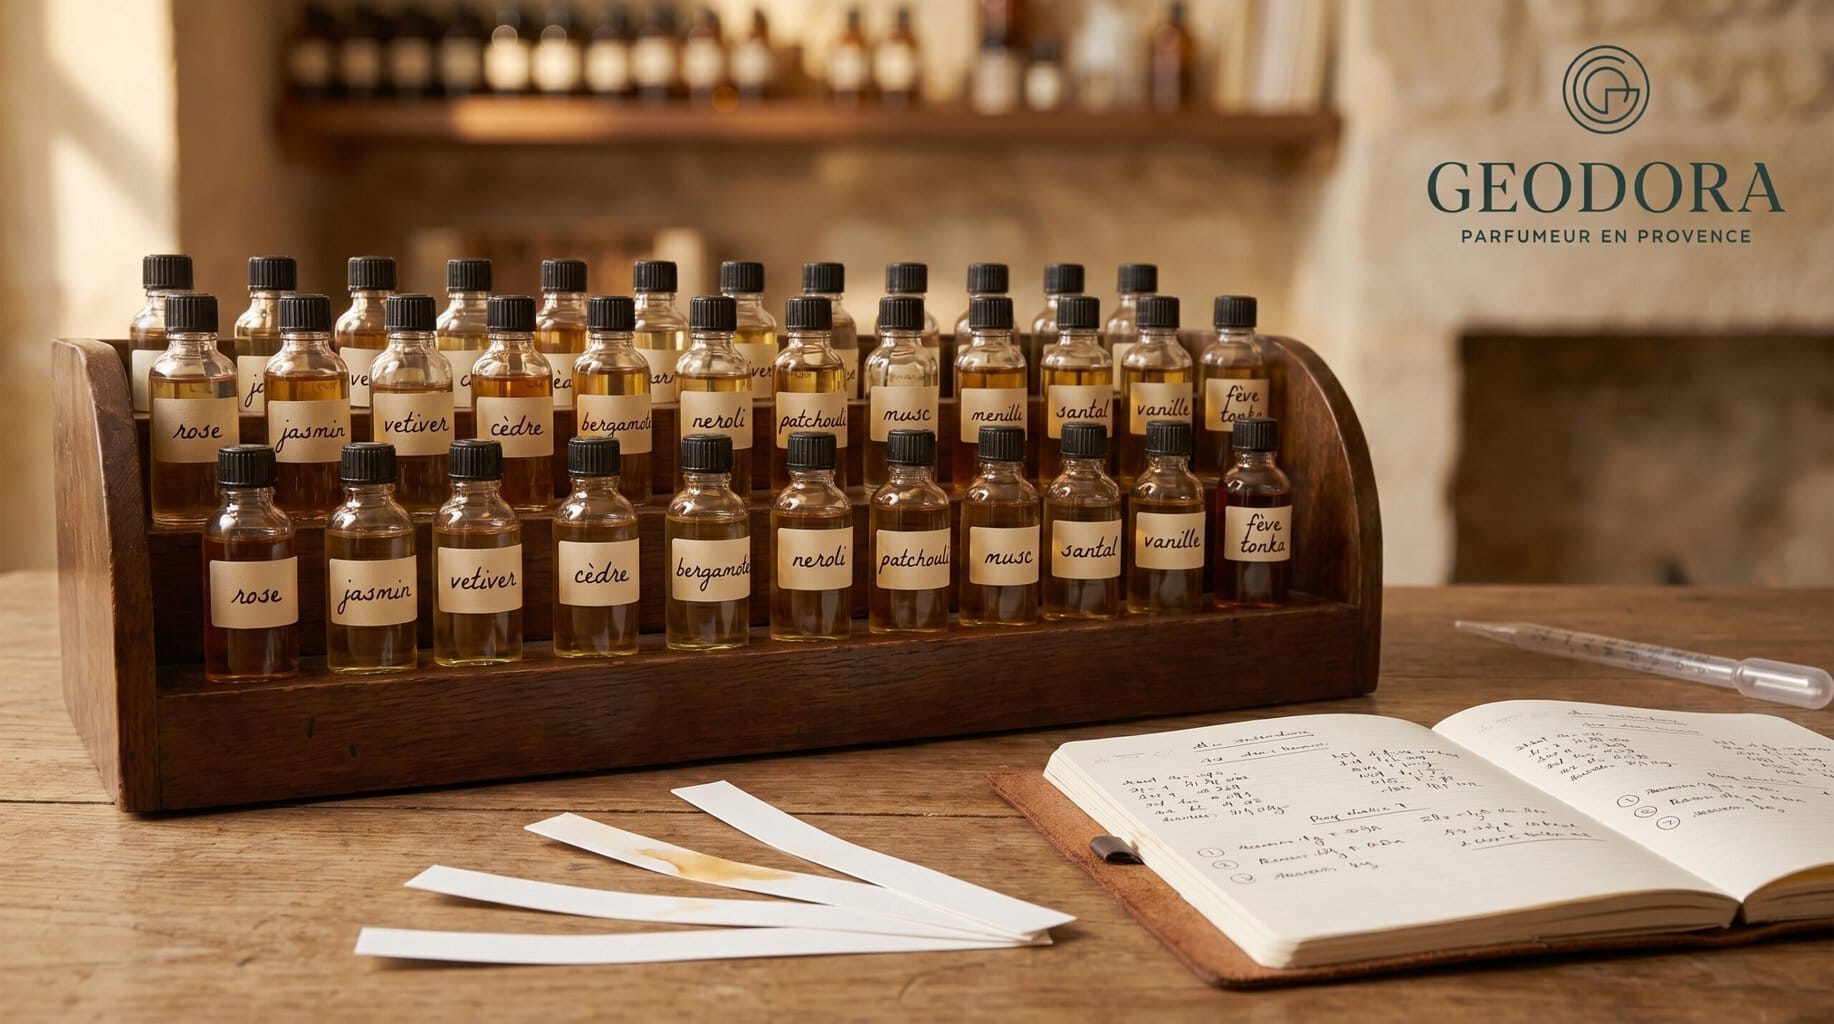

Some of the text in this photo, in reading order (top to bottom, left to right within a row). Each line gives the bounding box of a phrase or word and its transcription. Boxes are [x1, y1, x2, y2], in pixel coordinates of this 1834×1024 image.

[1056, 398, 1110, 419] santal
[1137, 398, 1190, 417] vanille
[1226, 385, 1260, 411] fève
[384, 411, 449, 434] vetiver
[491, 414, 545, 436] cèdre
[692, 407, 746, 429] neroli
[779, 407, 847, 434] patchouli
[883, 408, 931, 421] musc
[173, 423, 223, 440] rose
[276, 419, 346, 452] jasmin
[1246, 513, 1282, 540] fève
[1061, 536, 1119, 558] santal
[1144, 528, 1201, 549] vanille
[1241, 533, 1286, 553] tonka
[792, 545, 847, 568] neroli
[879, 545, 950, 575] patchouli
[985, 550, 1033, 565] musc
[451, 566, 517, 590] vetiver
[575, 561, 630, 584] cèdre
[231, 588, 283, 604] rose
[337, 579, 412, 615] jasmin
